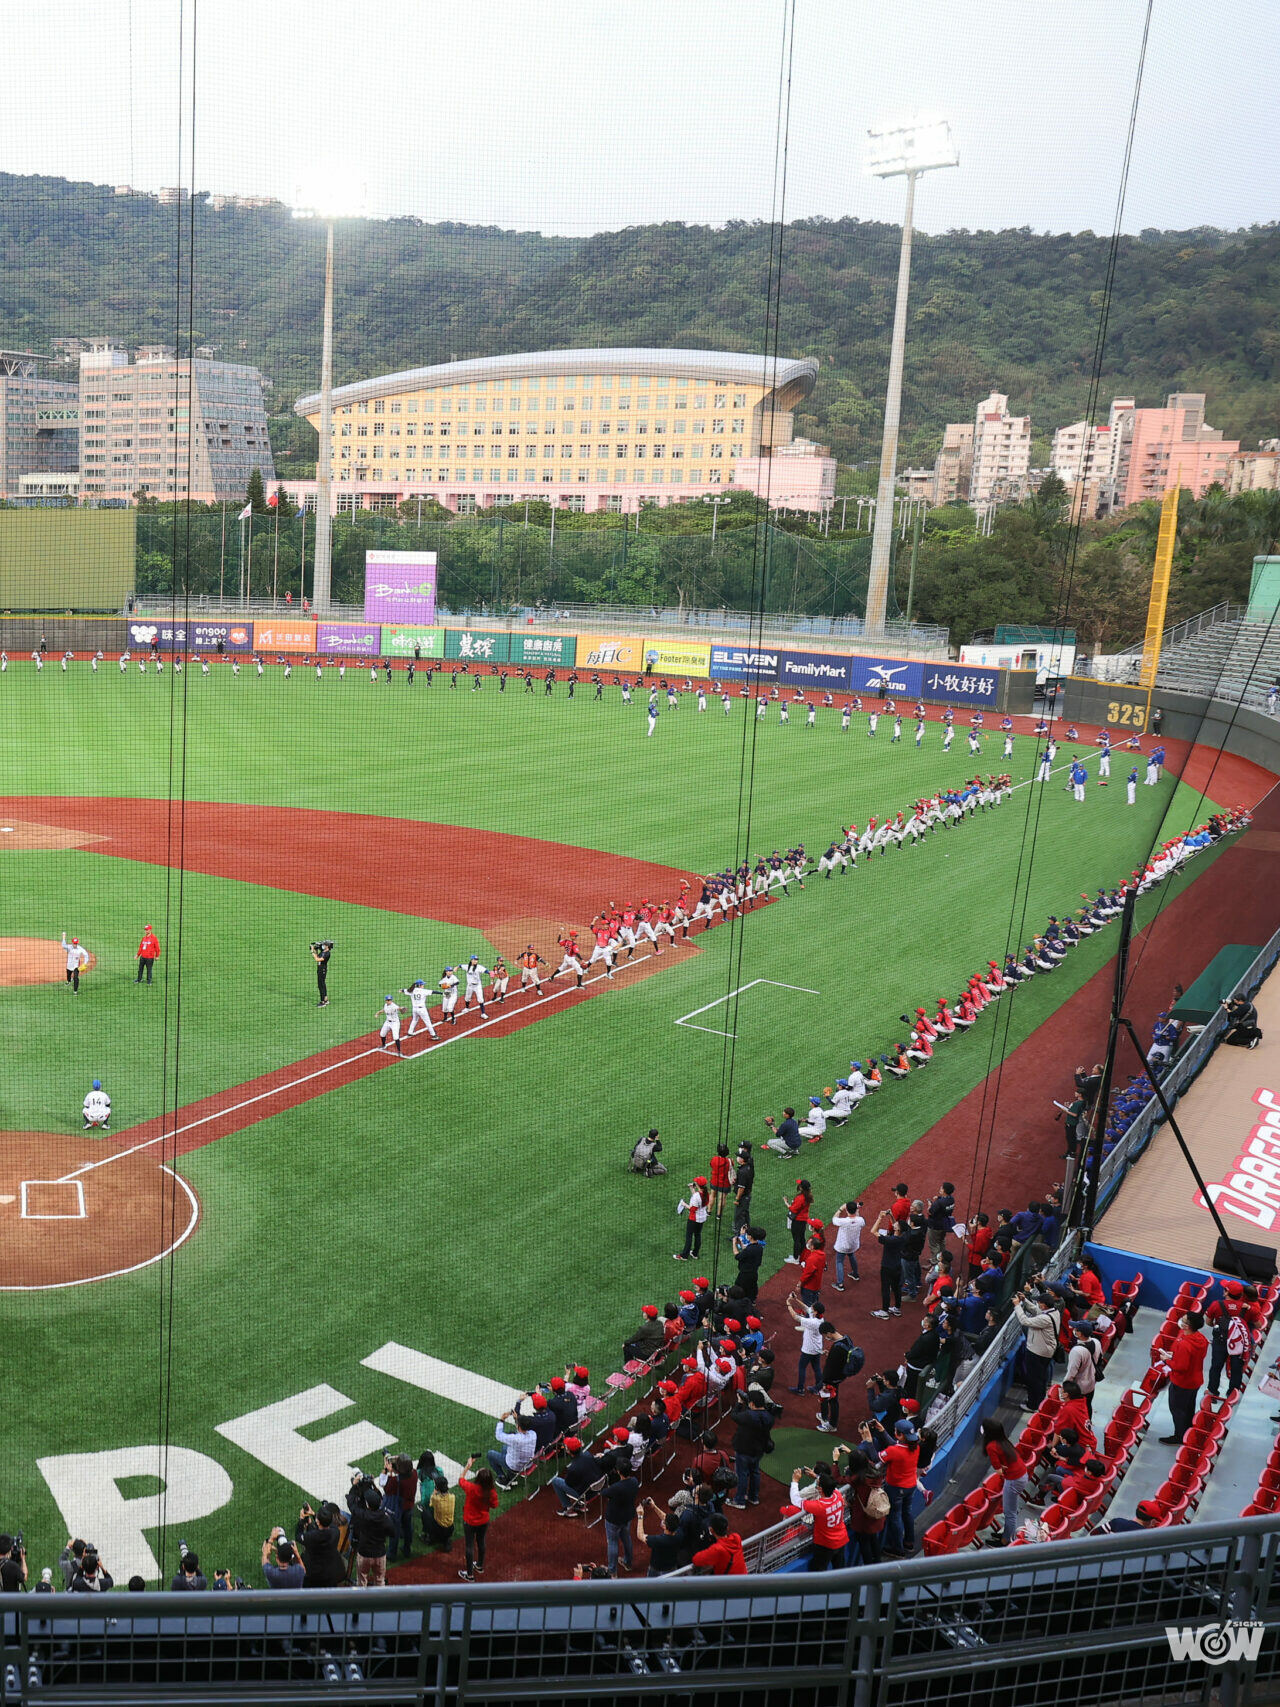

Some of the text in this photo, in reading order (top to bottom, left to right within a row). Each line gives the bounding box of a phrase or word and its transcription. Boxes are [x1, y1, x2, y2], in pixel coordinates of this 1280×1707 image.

[162, 629, 186, 641] 味全
[713, 650, 778, 667] ELEVEN
[785, 661, 846, 678] FamilyMart
[927, 673, 995, 696] 小牧好好
[1106, 701, 1146, 727] 325
[827, 1510, 842, 1528] 27
